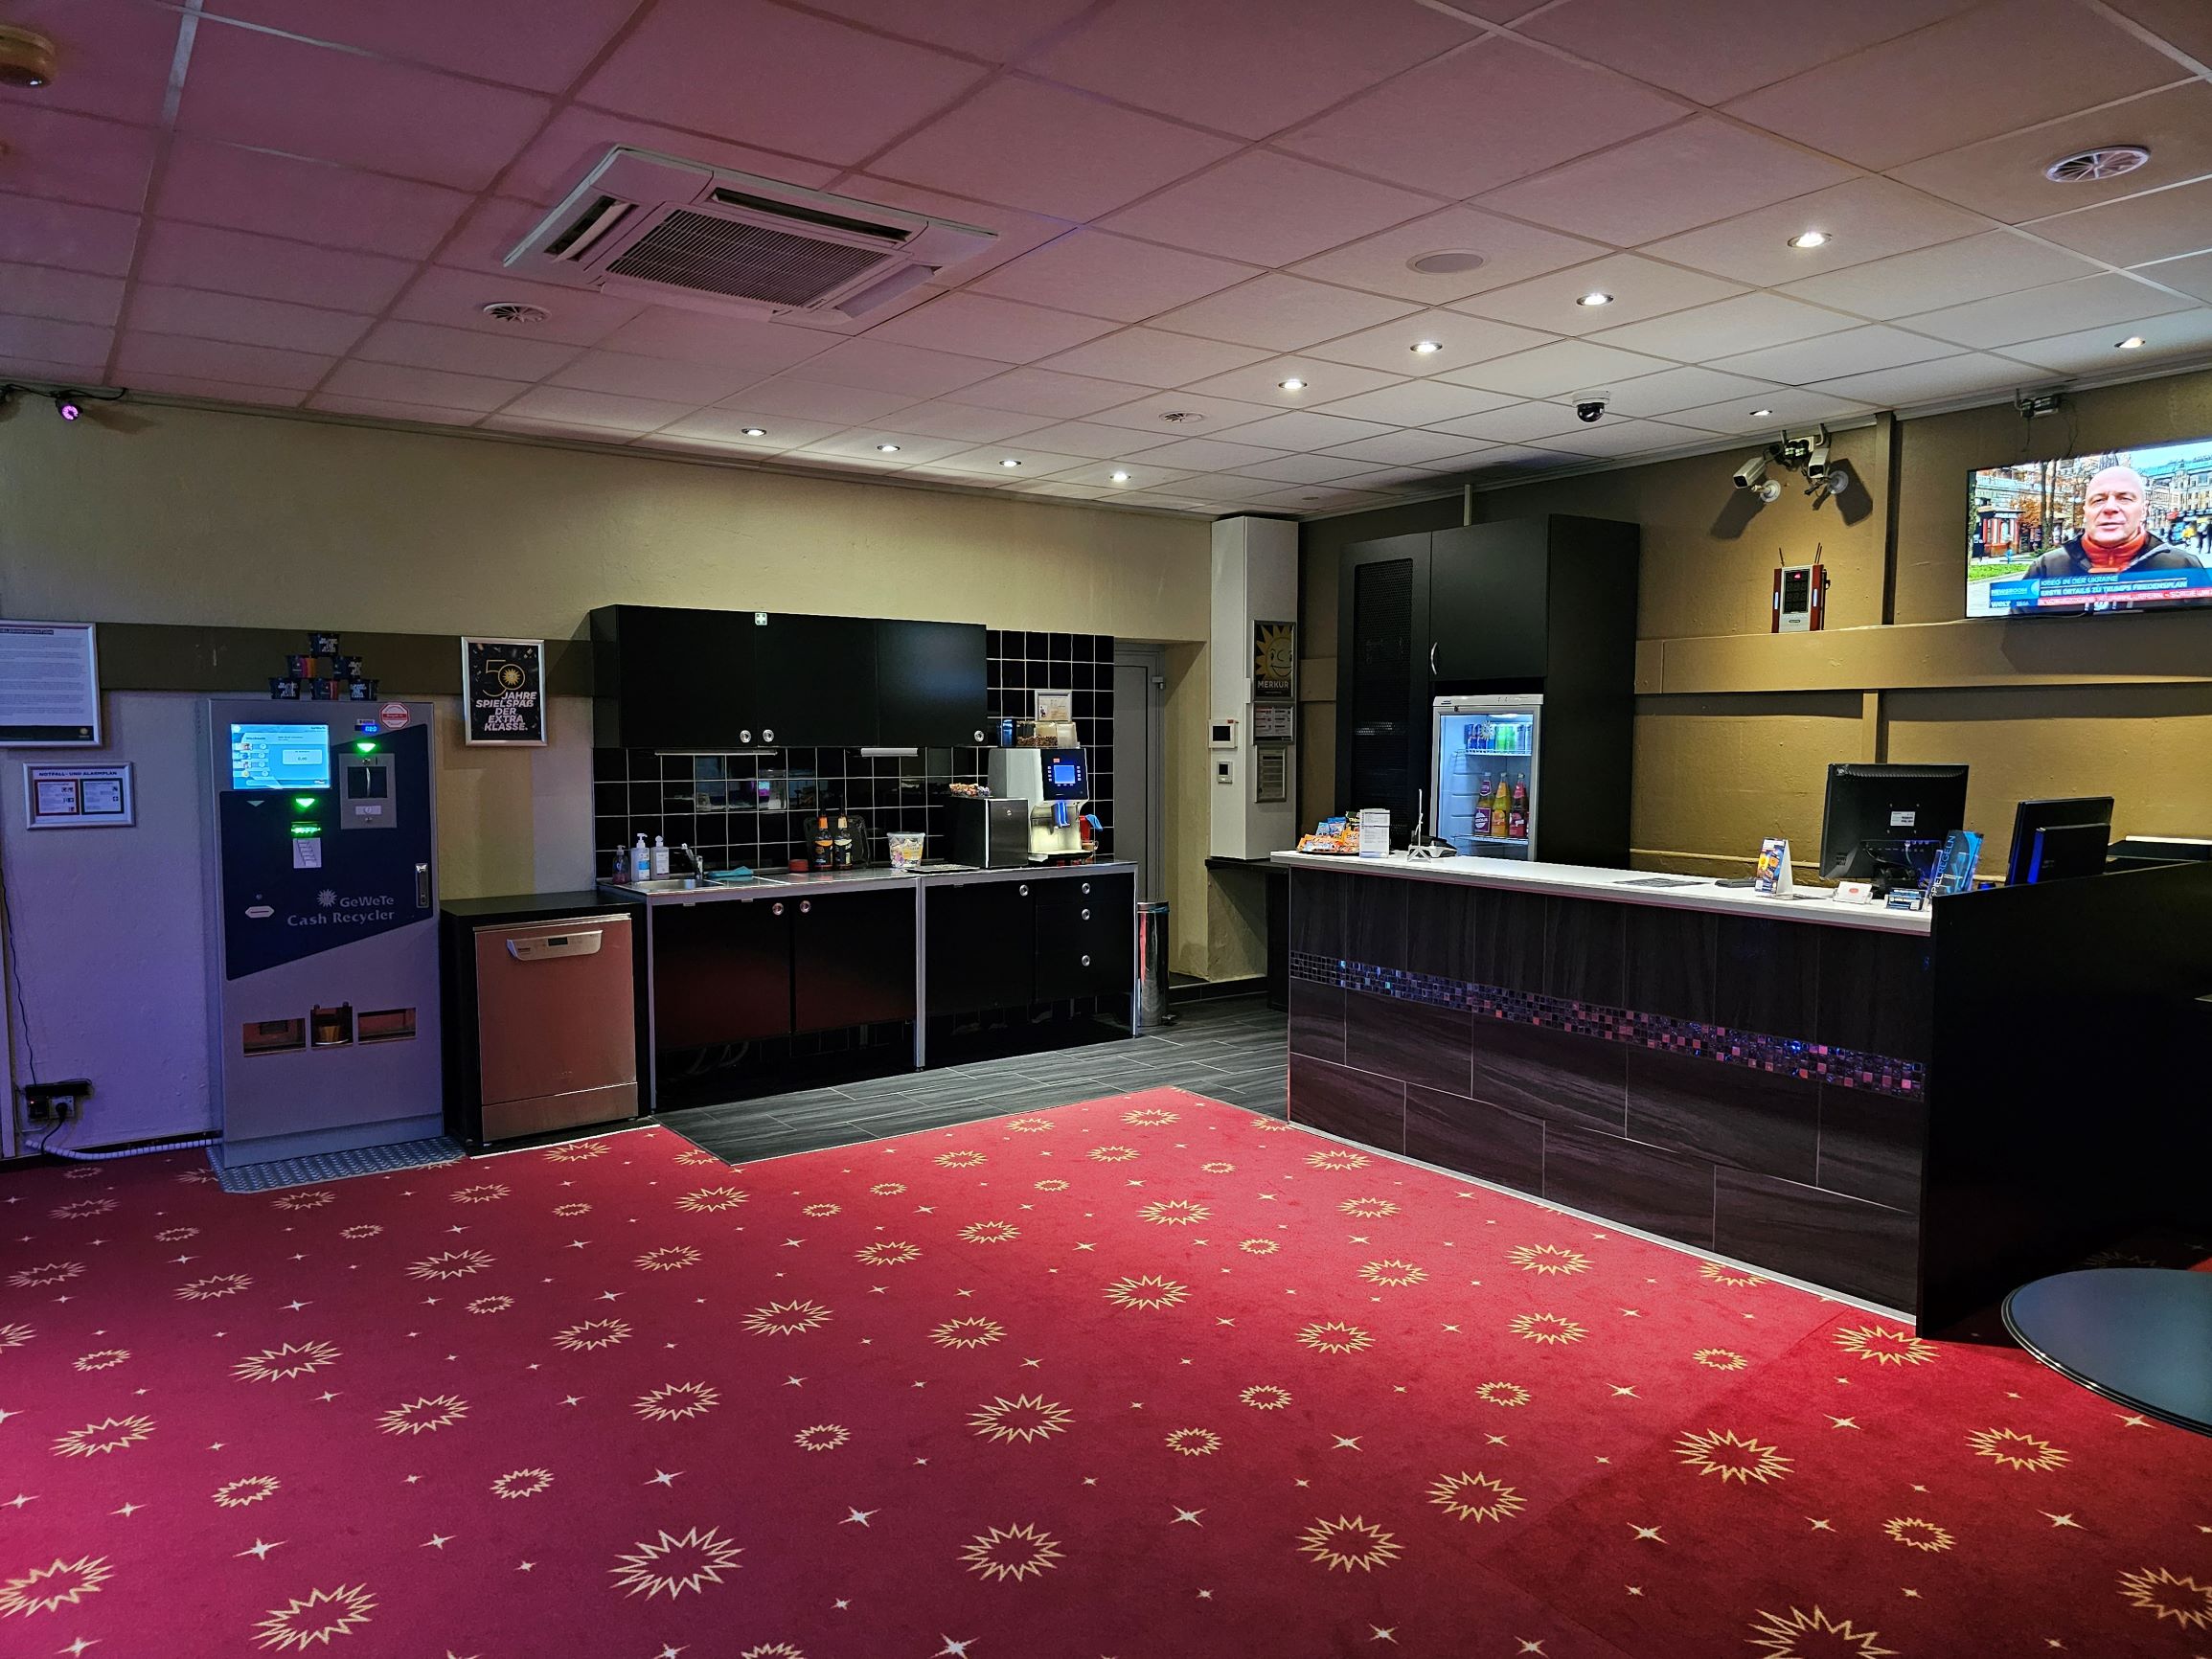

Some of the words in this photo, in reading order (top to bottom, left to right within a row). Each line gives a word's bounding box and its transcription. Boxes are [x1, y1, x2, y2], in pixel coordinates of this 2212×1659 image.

[2087, 575, 2118, 583] UKRAINE
[1257, 680, 1289, 689] MERKUR
[501, 692, 537, 700] JAHRE
[494, 707, 517, 716] DER
[488, 715, 524, 723] EXTRA
[484, 722, 529, 732] KLASSE.
[339, 896, 395, 908] GeWeTe
[287, 913, 328, 926] Cash
[332, 909, 396, 924] Recycler
